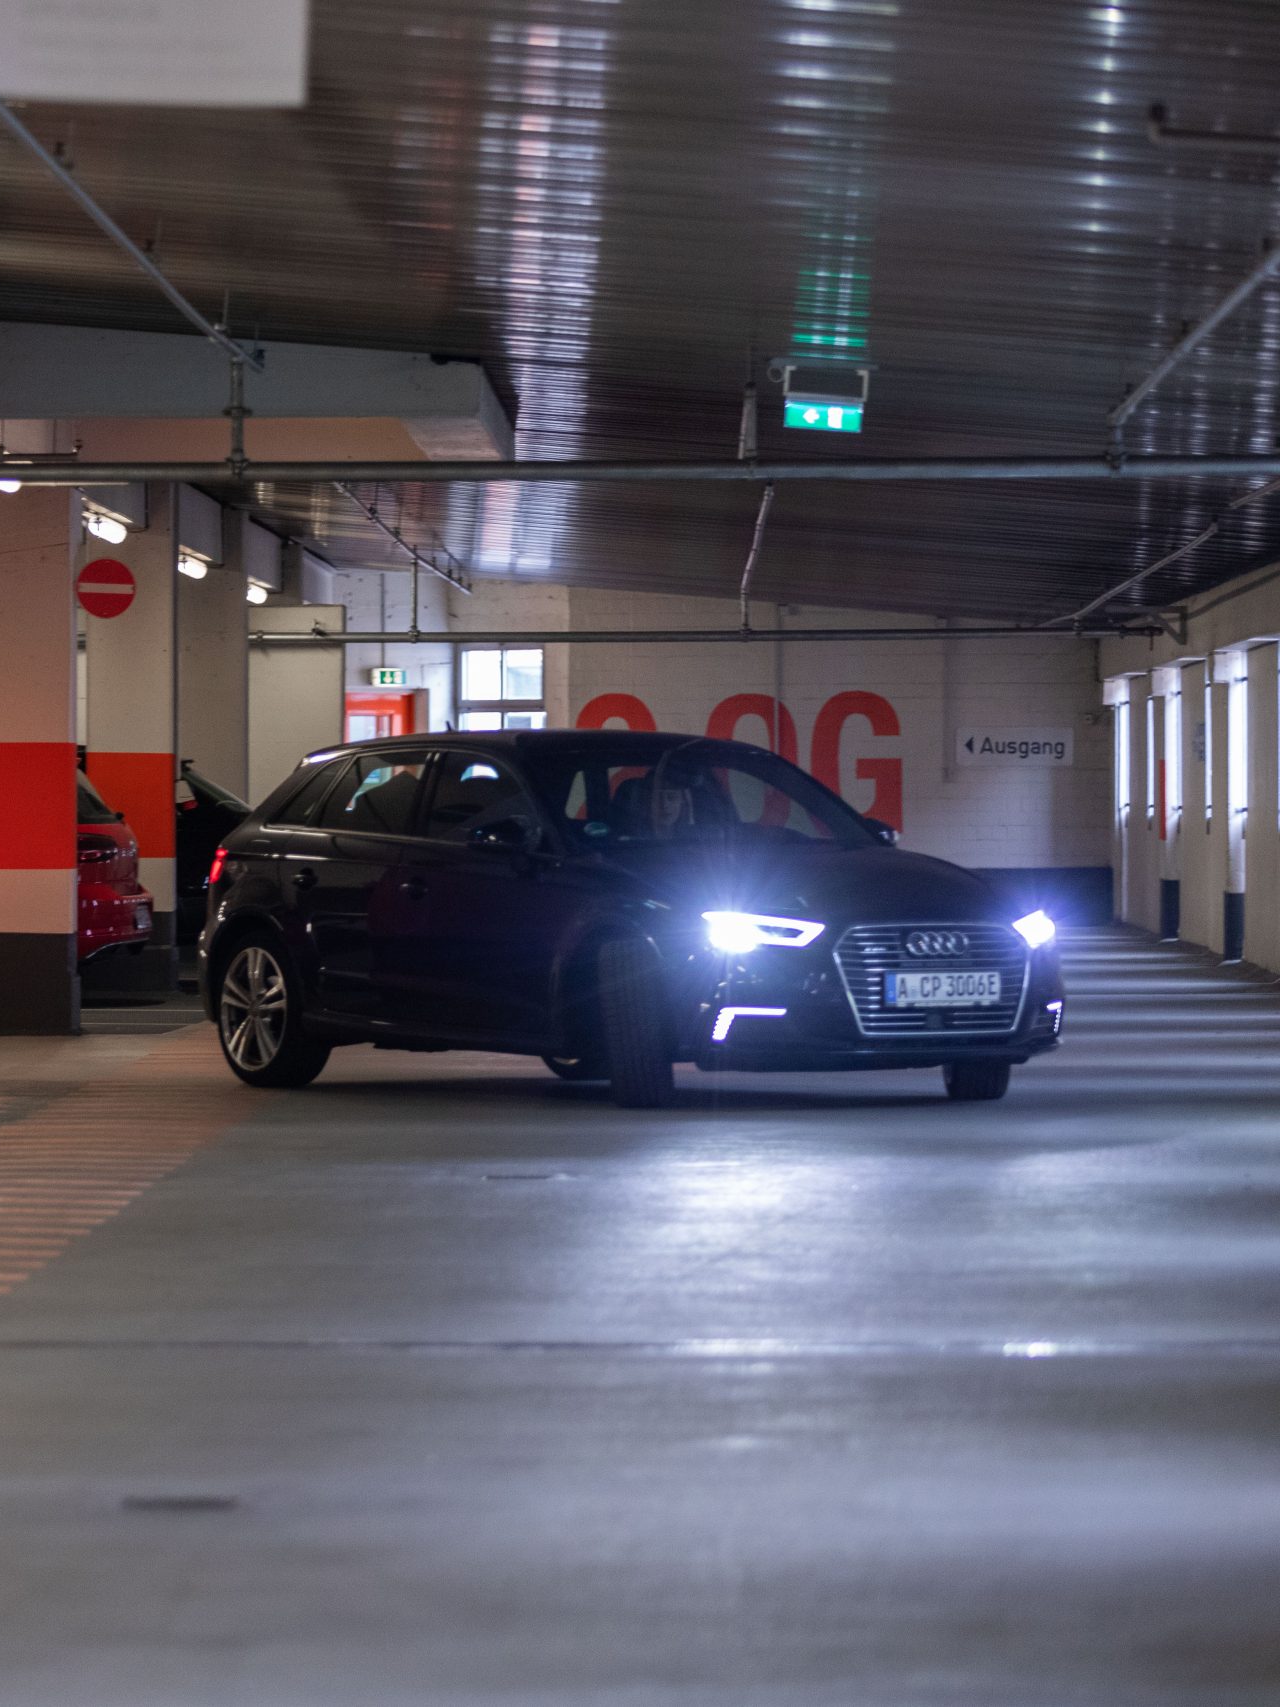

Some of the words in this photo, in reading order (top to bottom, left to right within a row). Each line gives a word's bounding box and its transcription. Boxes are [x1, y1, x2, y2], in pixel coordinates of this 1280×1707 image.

[980, 737, 1065, 759] Ausgang
[705, 690, 904, 838] OG
[898, 977, 908, 999] A
[920, 976, 942, 998] CP
[945, 974, 998, 997] 3006E
